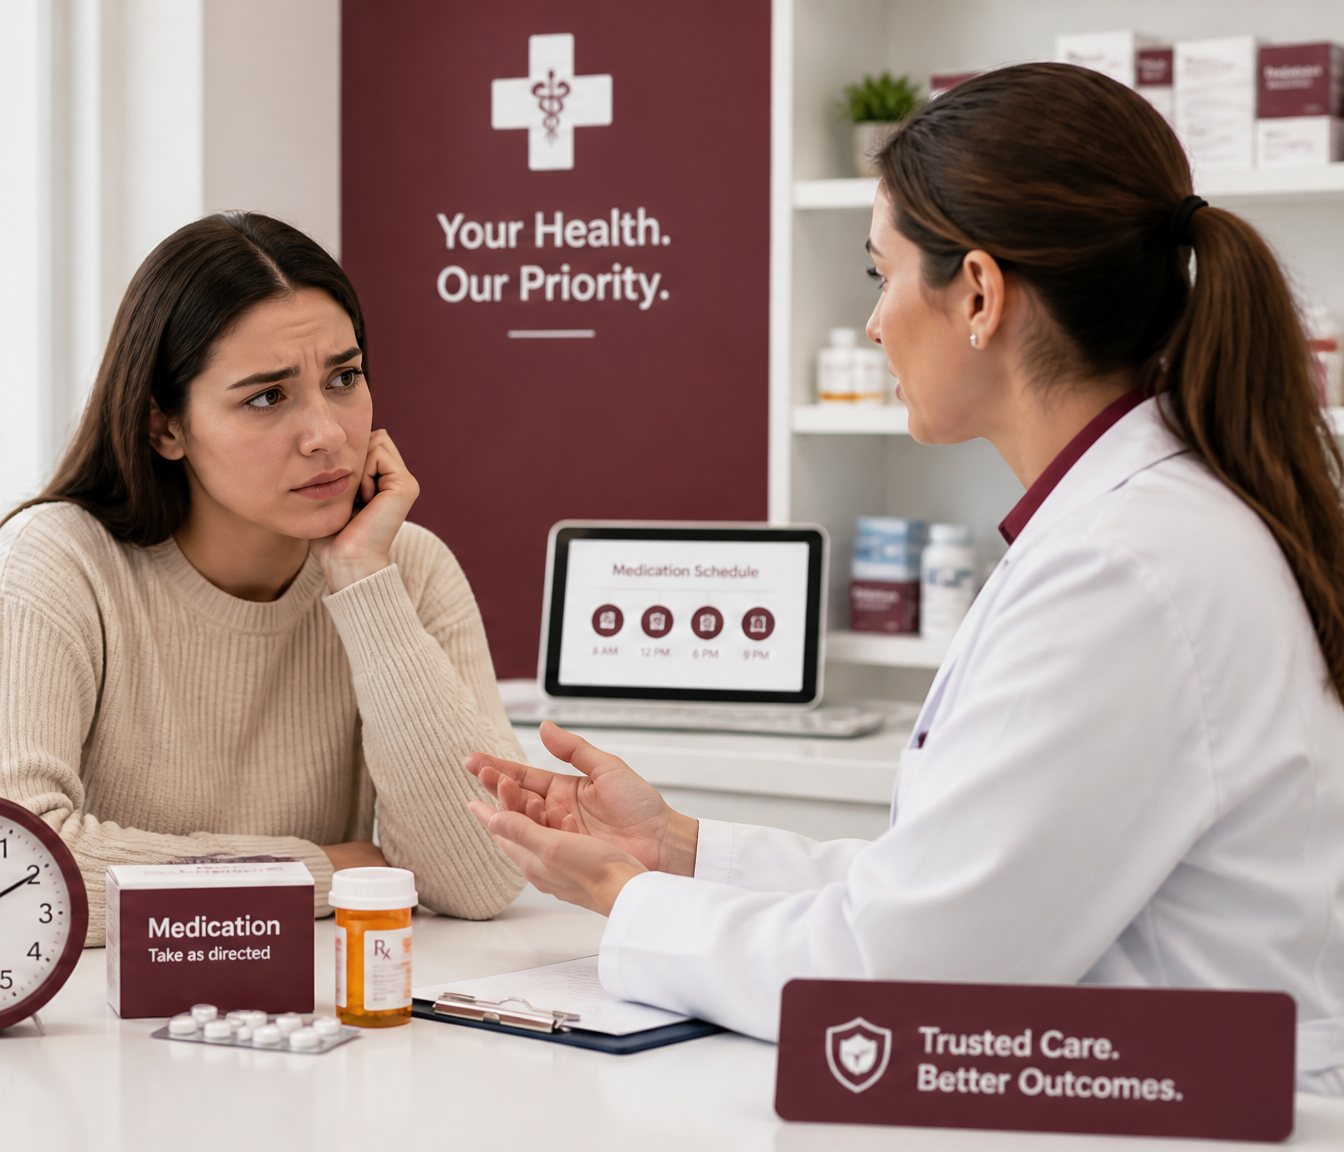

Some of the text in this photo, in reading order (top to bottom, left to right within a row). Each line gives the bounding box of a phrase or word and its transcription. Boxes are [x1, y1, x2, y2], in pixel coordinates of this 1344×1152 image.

[437, 207, 671, 250] Your Health.
[437, 263, 670, 311] Our Priority.
[612, 563, 759, 579] Medication Schedule
[601, 647, 618, 656] AM
[641, 647, 670, 657] 12 PM
[702, 649, 719, 659] PM
[752, 651, 769, 660] PM
[0, 838, 8, 859] 1
[26, 864, 41, 885] 2
[38, 903, 53, 924] 3
[147, 915, 281, 939] Medication
[26, 941, 42, 961] 4
[148, 946, 271, 963] Take as directed
[0, 969, 13, 989] 5
[918, 1026, 1120, 1060] Trusted Care.
[917, 1064, 1184, 1101] Better Outcomes.
